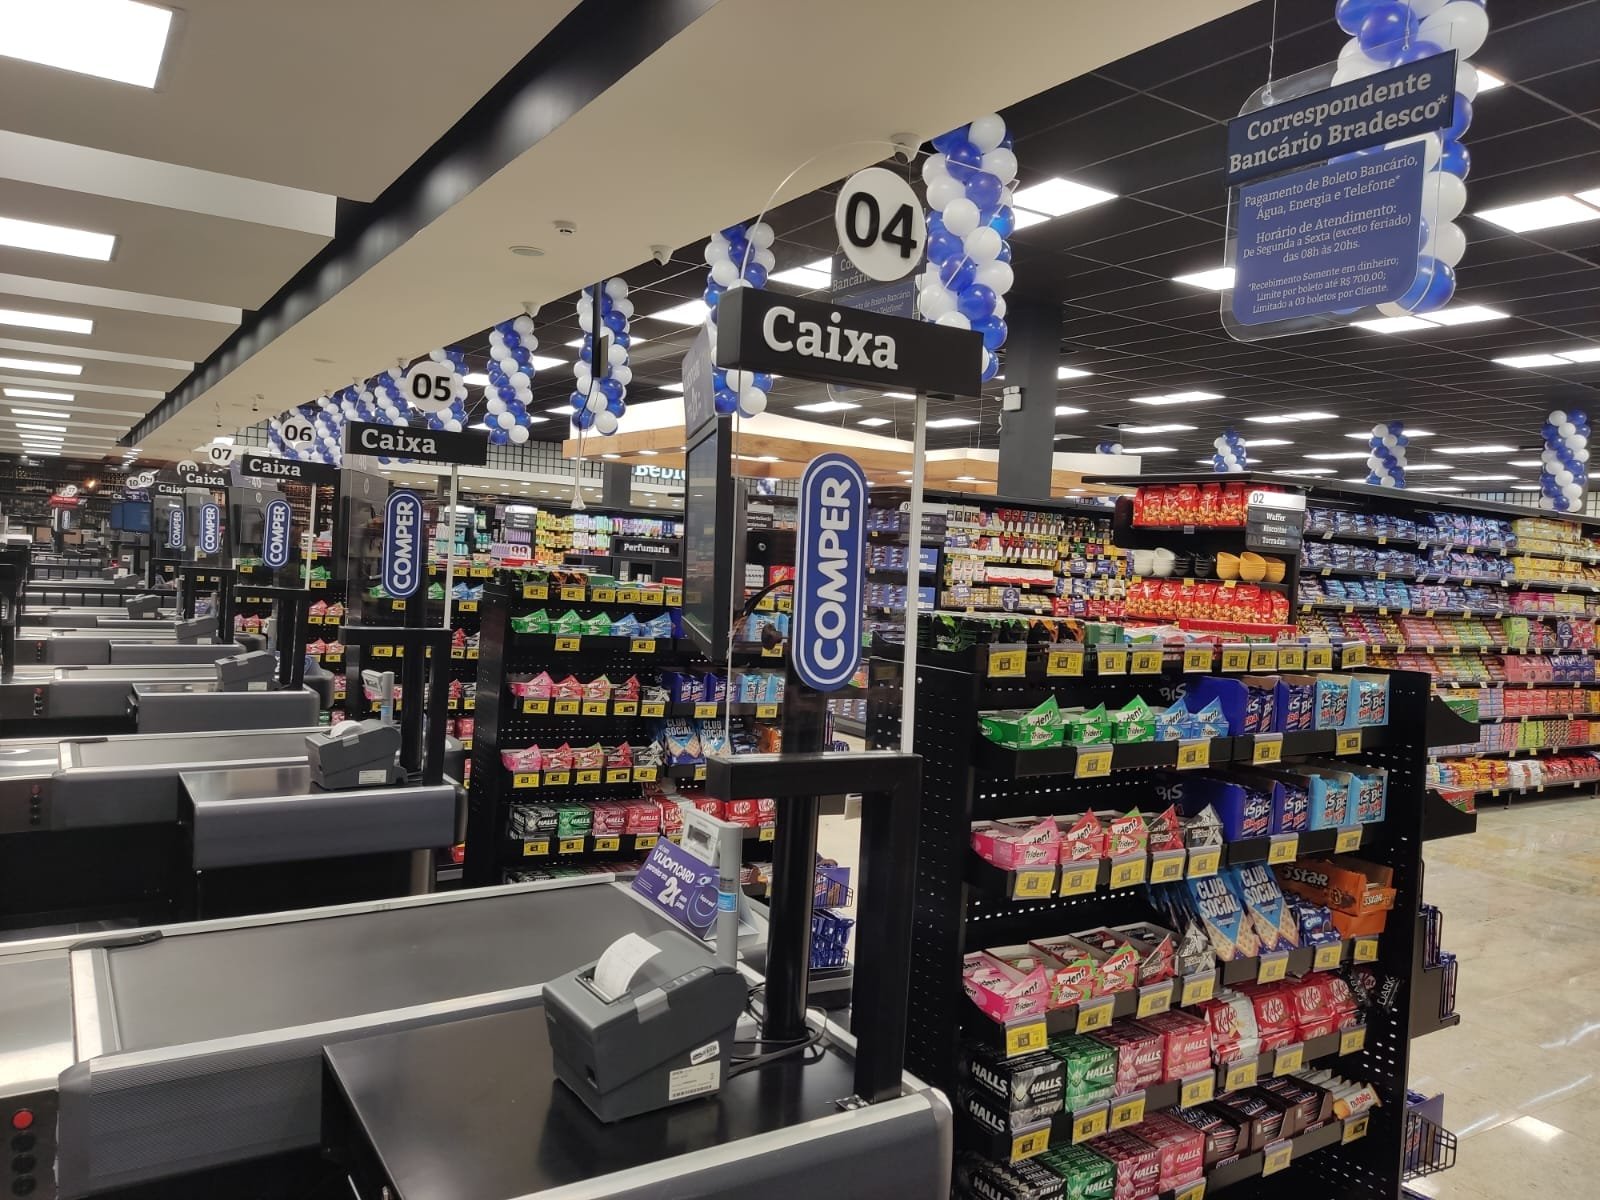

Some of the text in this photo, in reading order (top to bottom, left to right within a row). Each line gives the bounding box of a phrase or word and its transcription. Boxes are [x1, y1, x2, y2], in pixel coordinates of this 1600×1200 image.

[1248, 73, 1431, 141] Correspondente
[1229, 131, 1322, 173] Bancário
[1245, 155, 1418, 207] Pagamento de Boleto Bancário,
[1257, 203, 1286, 220] Água,
[1289, 193, 1332, 211] Energia
[1335, 192, 1341, 200] e
[845, 191, 917, 259] 04
[1243, 249, 1254, 258] De
[1256, 238, 1295, 256] Segunda
[1305, 231, 1330, 245] Sexta
[1332, 224, 1368, 240] (exceto
[1370, 212, 1411, 231] feriado)
[1256, 204, 1397, 243] Horário de Atendimento:
[1283, 252, 1299, 263] das
[1301, 247, 1319, 259] 08h
[763, 305, 898, 370] Caixa
[412, 373, 451, 401] 05
[284, 424, 313, 442] 06
[361, 428, 437, 454] Caixa
[211, 447, 232, 461] 07
[186, 473, 225, 486] Caixa
[250, 458, 301, 477] Caixa
[1253, 492, 1264, 504] 02
[172, 512, 181, 545] COMPER
[205, 508, 215, 550] COMPER
[270, 506, 286, 563] COMPER
[393, 501, 414, 589] COMPER
[624, 543, 670, 554] Perfumaria
[814, 477, 851, 670] COMPER
[1241, 865, 1268, 887] CLUB
[1196, 878, 1227, 899] CLUB
[1136, 1050, 1161, 1066] HALLS
[1184, 1041, 1208, 1053] HALLS
[971, 1061, 1008, 1096] HALLS
[1087, 1064, 1114, 1079] HALLS
[1031, 1077, 1062, 1094] HALLS
[1351, 1092, 1372, 1108] nutella
[969, 1100, 1005, 1132] HALLS
[1177, 1148, 1201, 1163] HALLS
[1134, 1164, 1160, 1179] HALLS
[1085, 1178, 1114, 1194] HALLS
